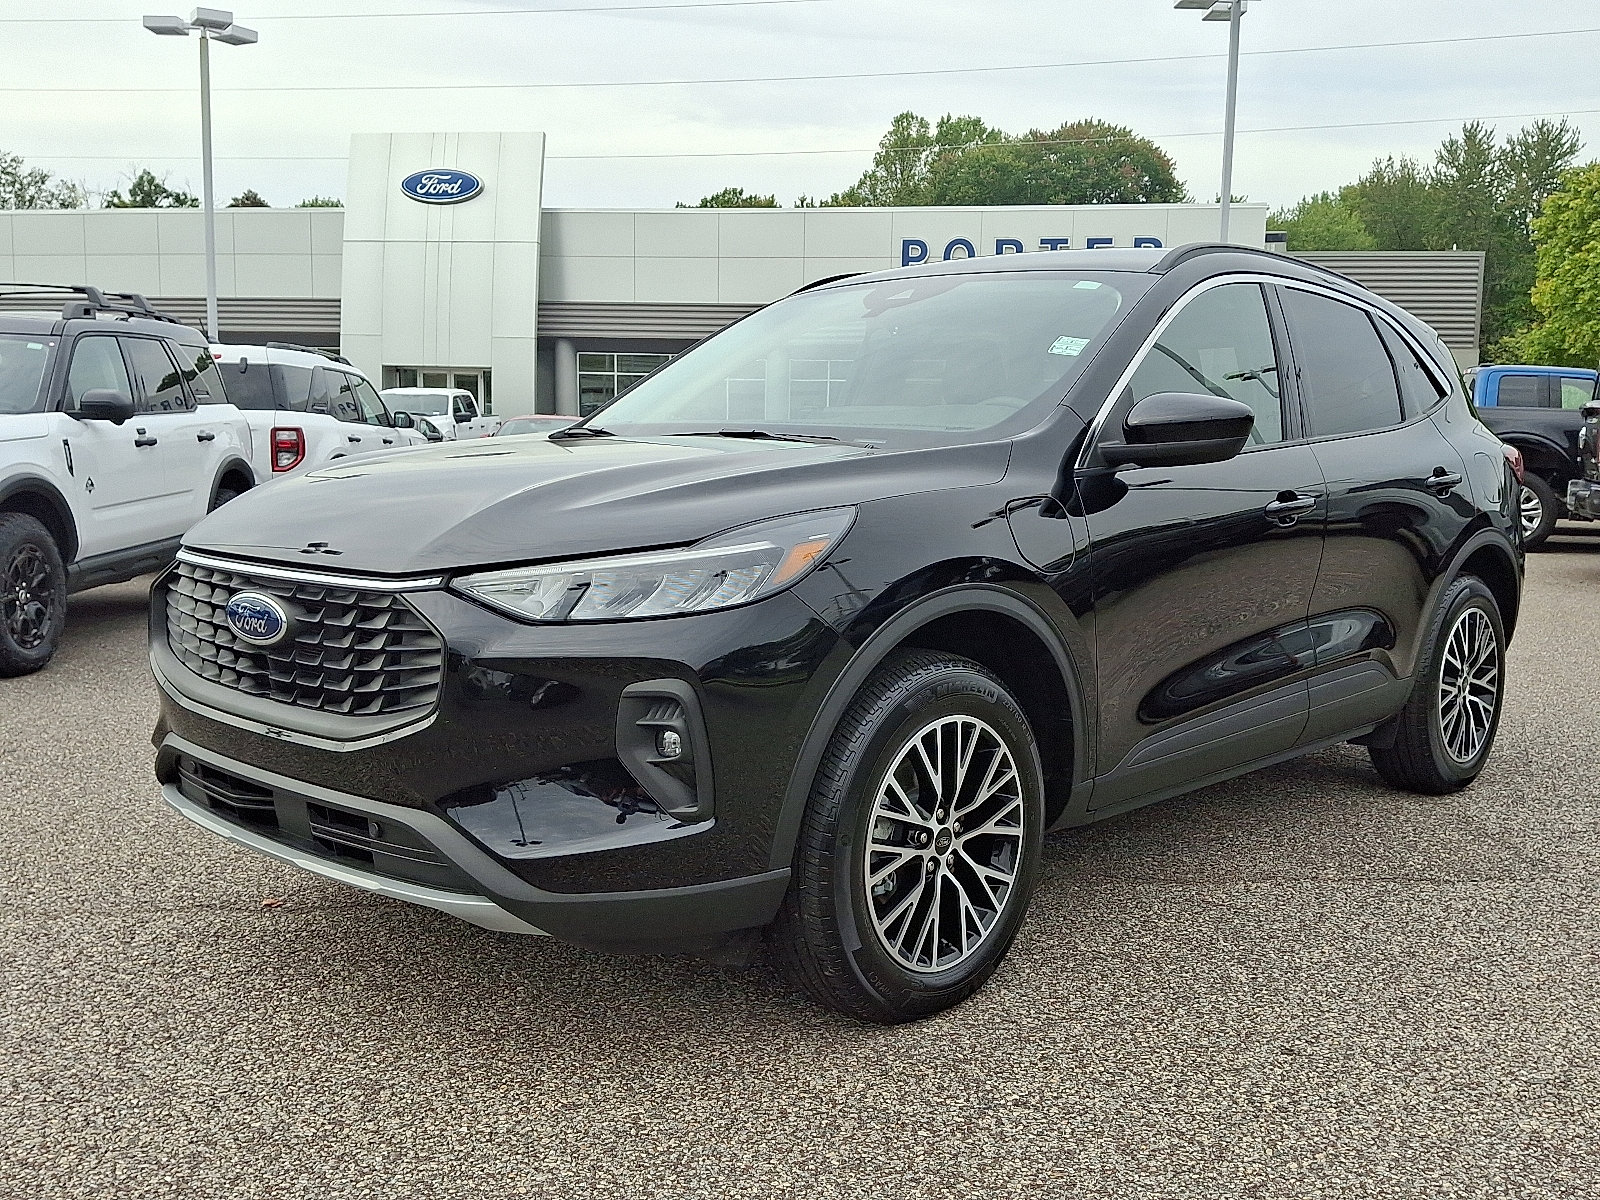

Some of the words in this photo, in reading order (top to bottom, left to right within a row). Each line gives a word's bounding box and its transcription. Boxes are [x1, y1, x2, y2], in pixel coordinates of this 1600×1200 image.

[416, 174, 463, 194] Ford
[900, 237, 1163, 268] POT
[235, 602, 269, 633] Ford
[937, 681, 997, 700] MICHELIN
